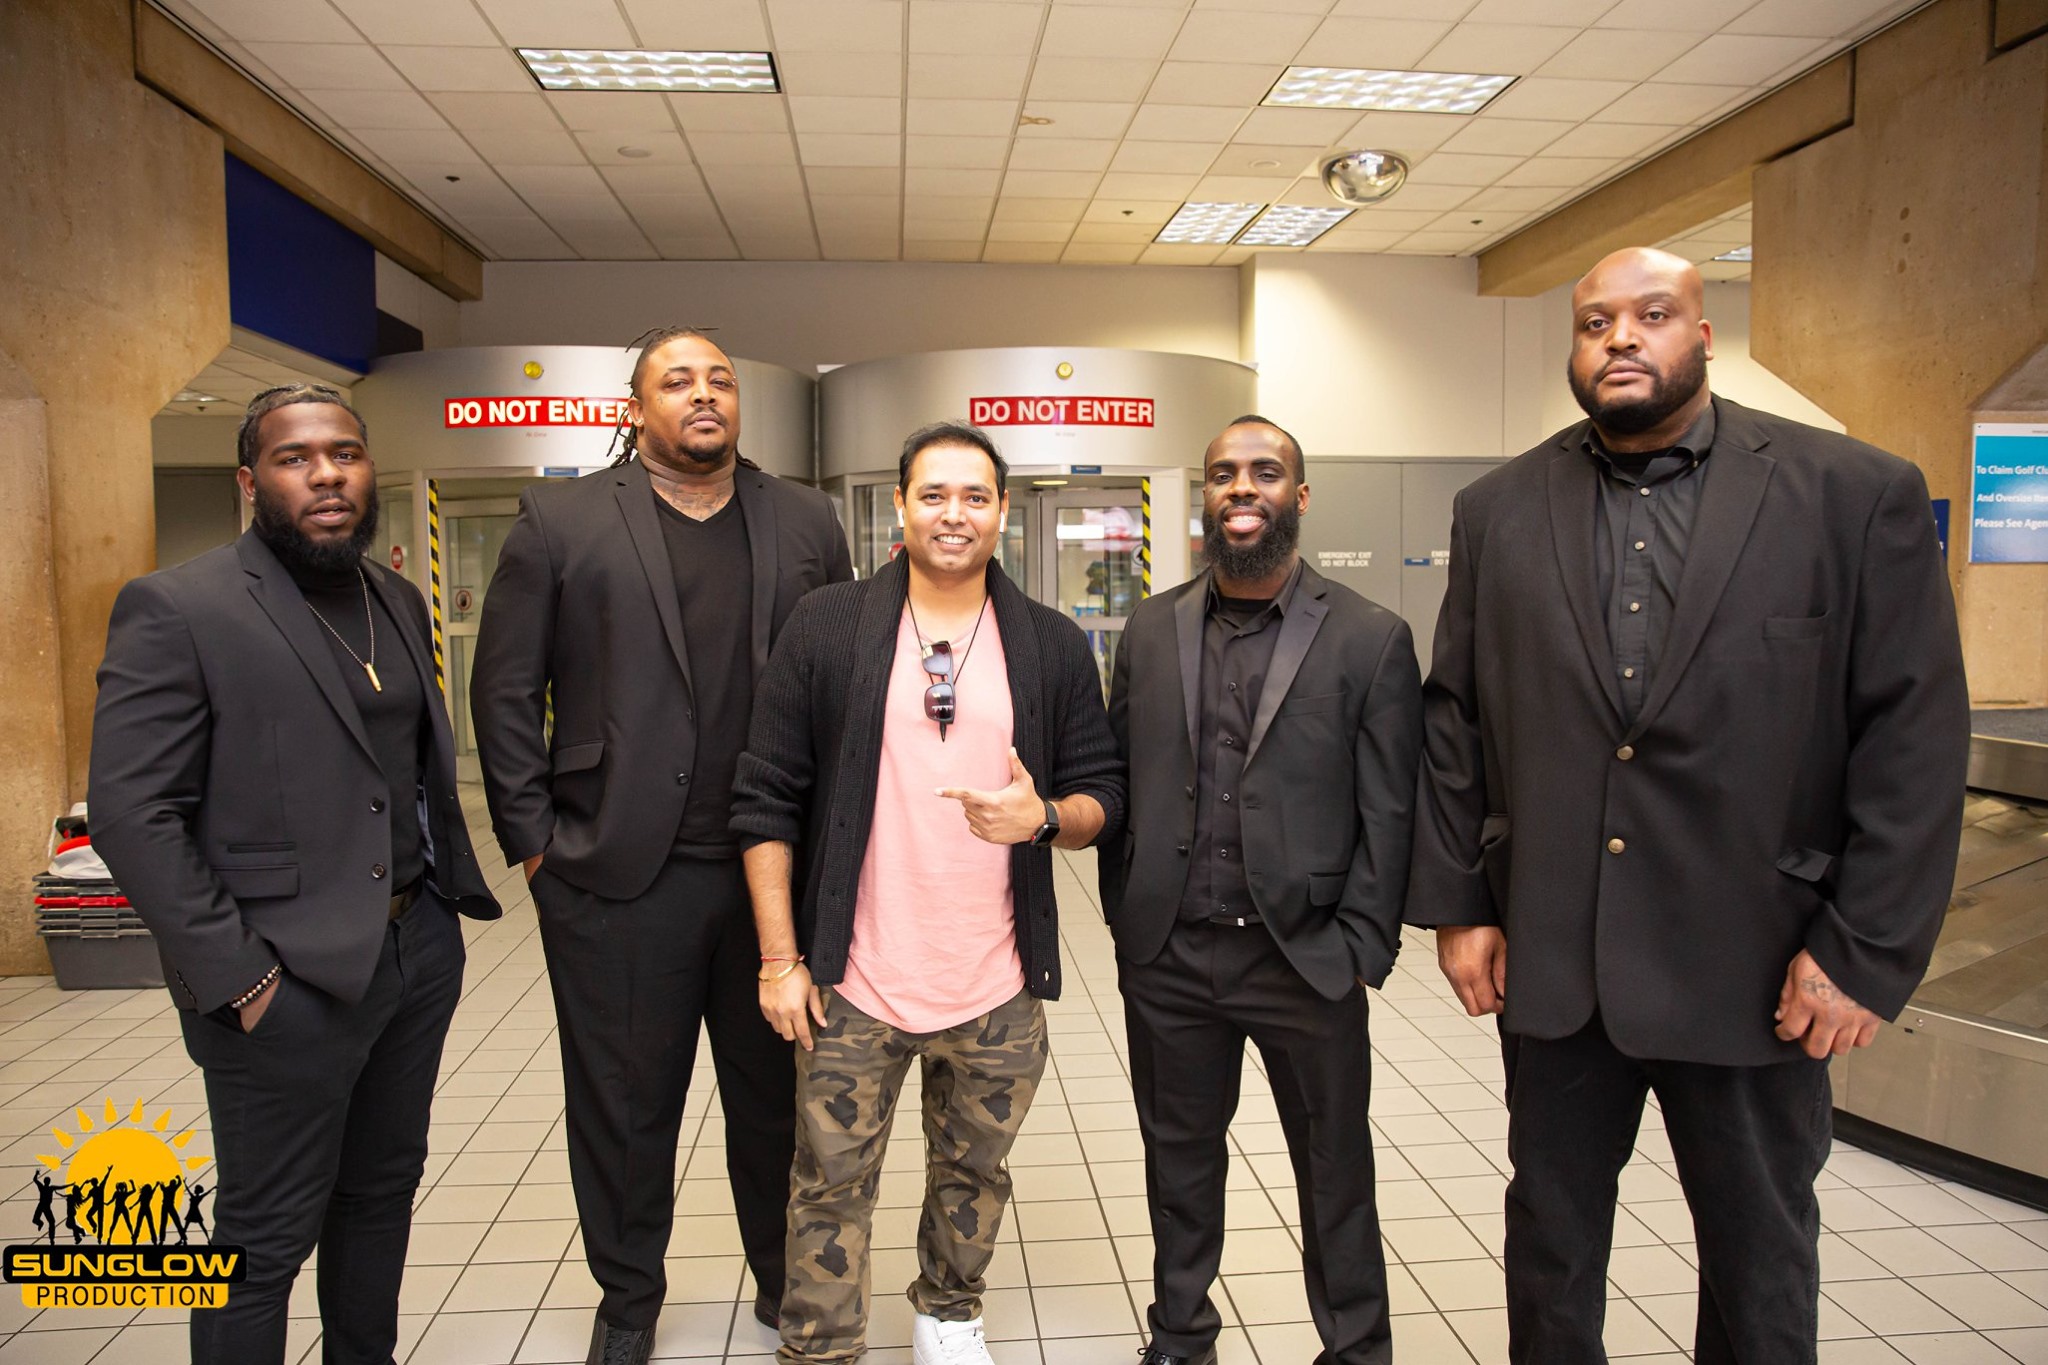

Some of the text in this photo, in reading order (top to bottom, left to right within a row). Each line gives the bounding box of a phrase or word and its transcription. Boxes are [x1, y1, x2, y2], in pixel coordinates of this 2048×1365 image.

[448, 401, 482, 425] DO
[489, 400, 541, 423] NOT
[974, 400, 1153, 423] DO NOT ENTER
[1976, 465, 1987, 475] To
[1988, 465, 2014, 475] Claim
[2015, 465, 2035, 475] Golf
[1976, 494, 1994, 503] And
[1974, 518, 2005, 528] Please
[2006, 518, 2023, 528] See
[1318, 551, 1372, 559] EMERGENCY EXIT
[1321, 559, 1369, 567] DO NOT BLOCK
